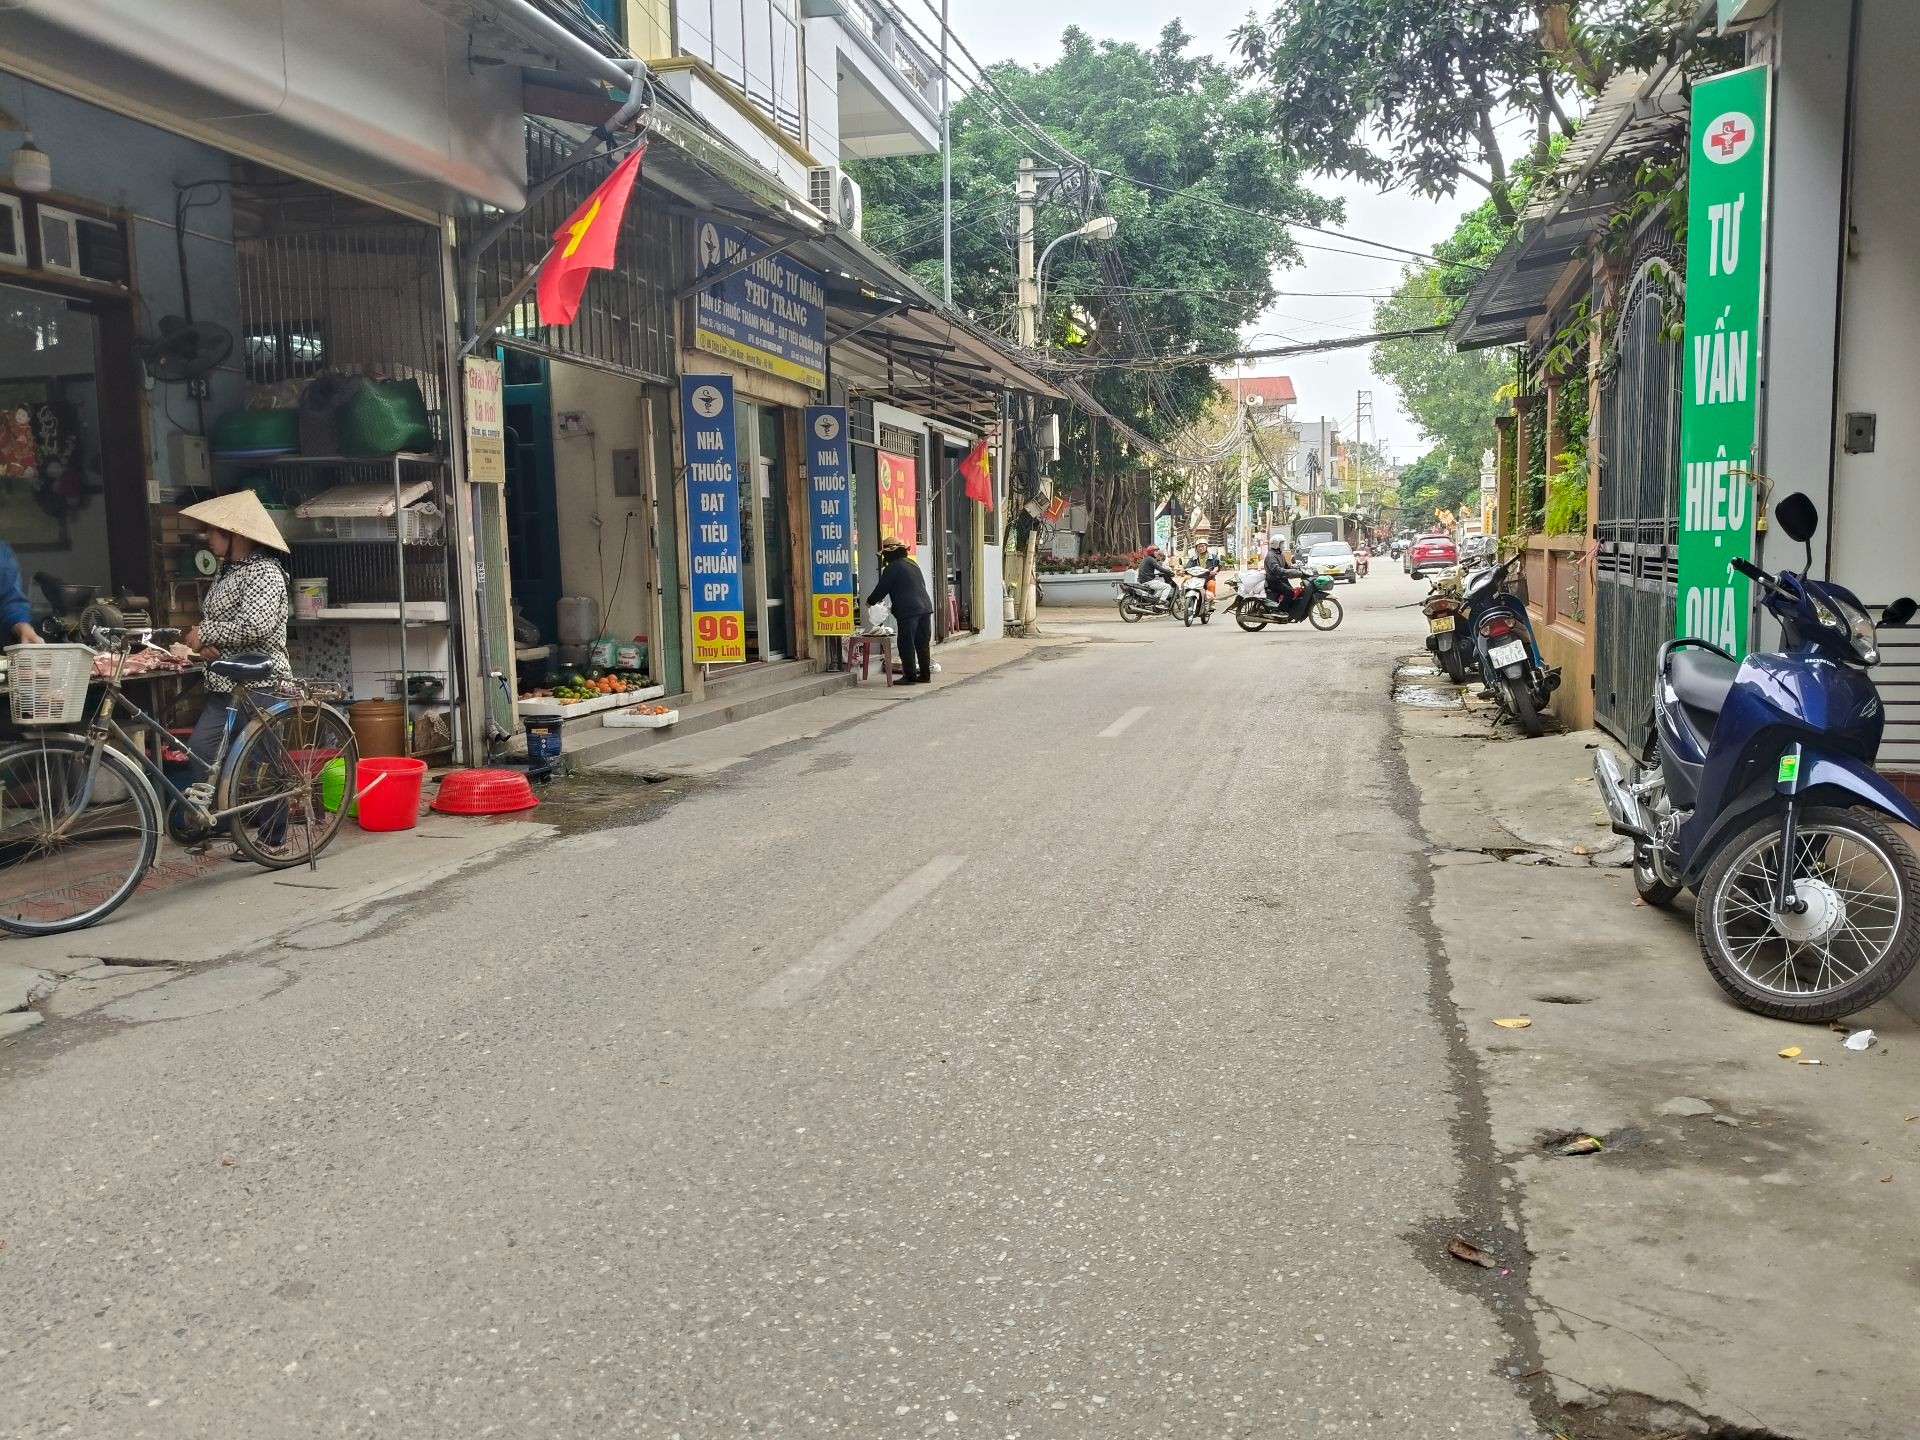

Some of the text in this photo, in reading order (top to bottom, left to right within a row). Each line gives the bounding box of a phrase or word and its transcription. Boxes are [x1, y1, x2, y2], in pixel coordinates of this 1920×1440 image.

[1708, 192, 1745, 277] TƯ
[751, 251, 783, 289] THUỐC
[786, 270, 798, 296] TƯ
[799, 277, 824, 309] NHÂN
[745, 278, 769, 309] THU
[772, 292, 808, 327] TRANG
[1694, 305, 1748, 406] VẤN
[697, 428, 724, 450] NHÀ
[818, 447, 839, 466] NHÀ
[691, 457, 732, 482] THUỐC
[813, 470, 846, 491] THUỐC
[701, 493, 725, 516] ĐẠT
[1685, 445, 1747, 548] HIỆU
[821, 500, 840, 518] ĐẠT
[700, 521, 728, 542] TIÊU
[821, 521, 842, 540] TIÊU
[694, 548, 737, 574] CHUẨN
[815, 543, 850, 565] CHUẨN
[823, 571, 843, 587] GPP
[704, 583, 730, 602] GPP
[818, 597, 850, 618] 96
[698, 615, 740, 642] 96
[697, 644, 719, 658] Thúy
[1805, 658, 1838, 670] HONDA
